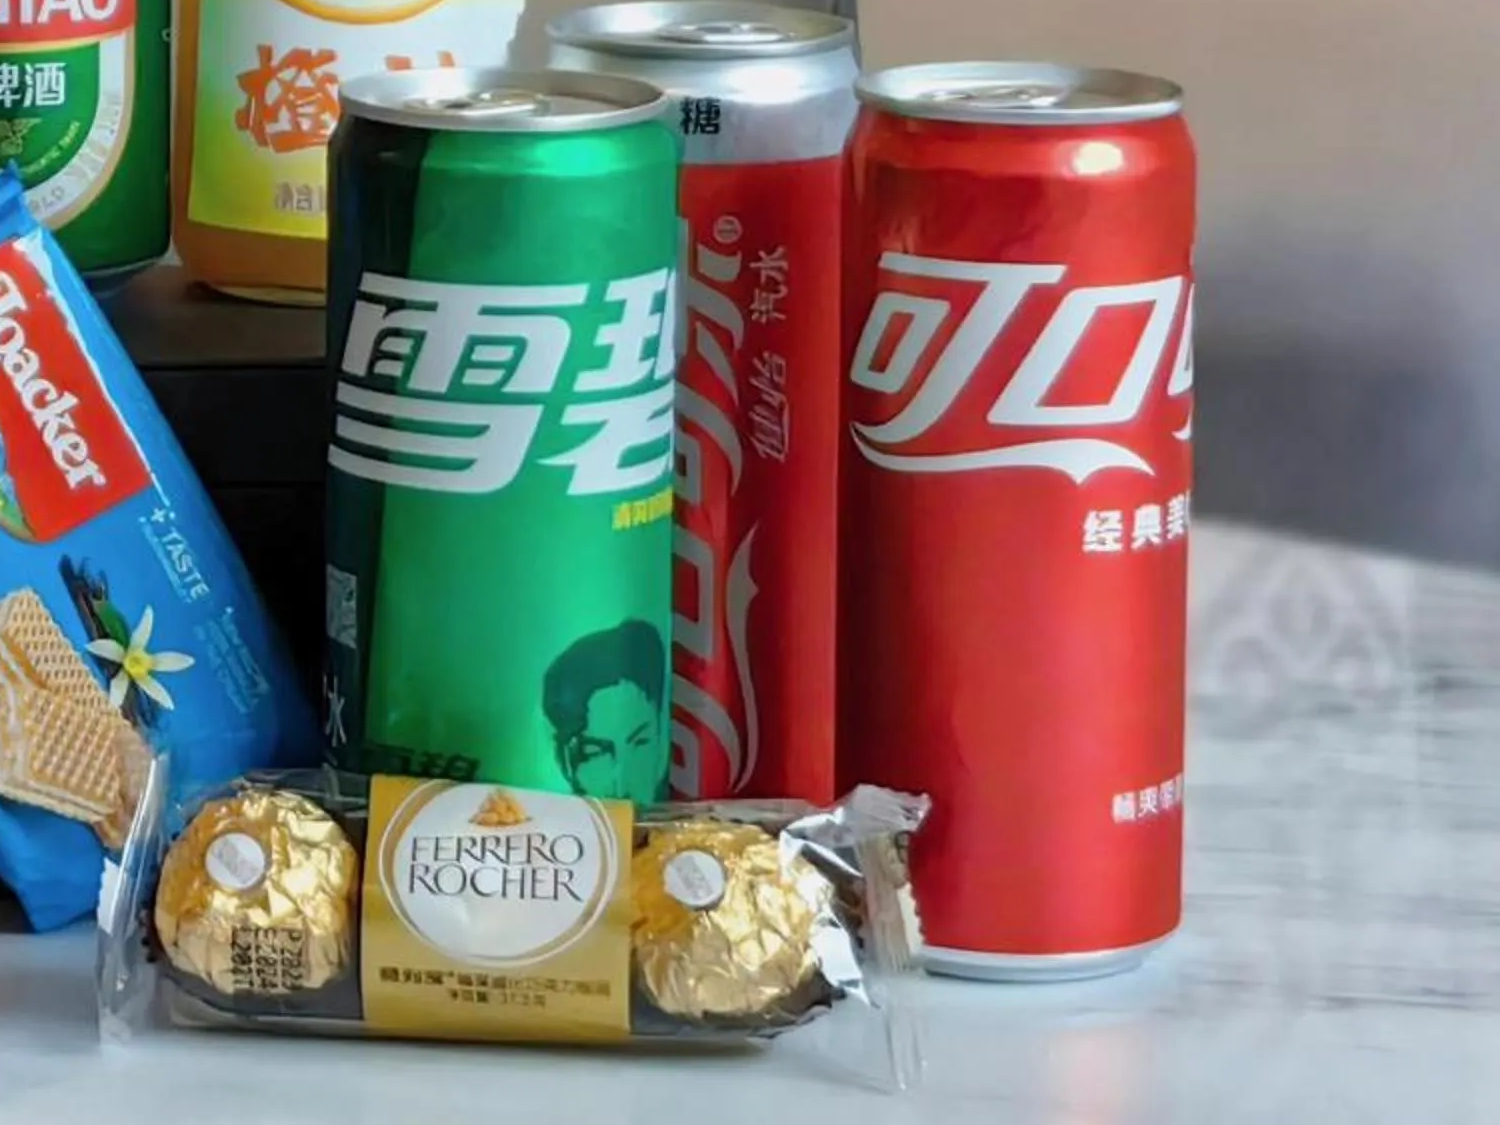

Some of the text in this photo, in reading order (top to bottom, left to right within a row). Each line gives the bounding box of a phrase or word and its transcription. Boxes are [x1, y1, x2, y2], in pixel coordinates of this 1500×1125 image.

[160, 526, 211, 601] TASTE
[411, 832, 584, 865] FERRERO
[408, 862, 584, 903] ROCHER
